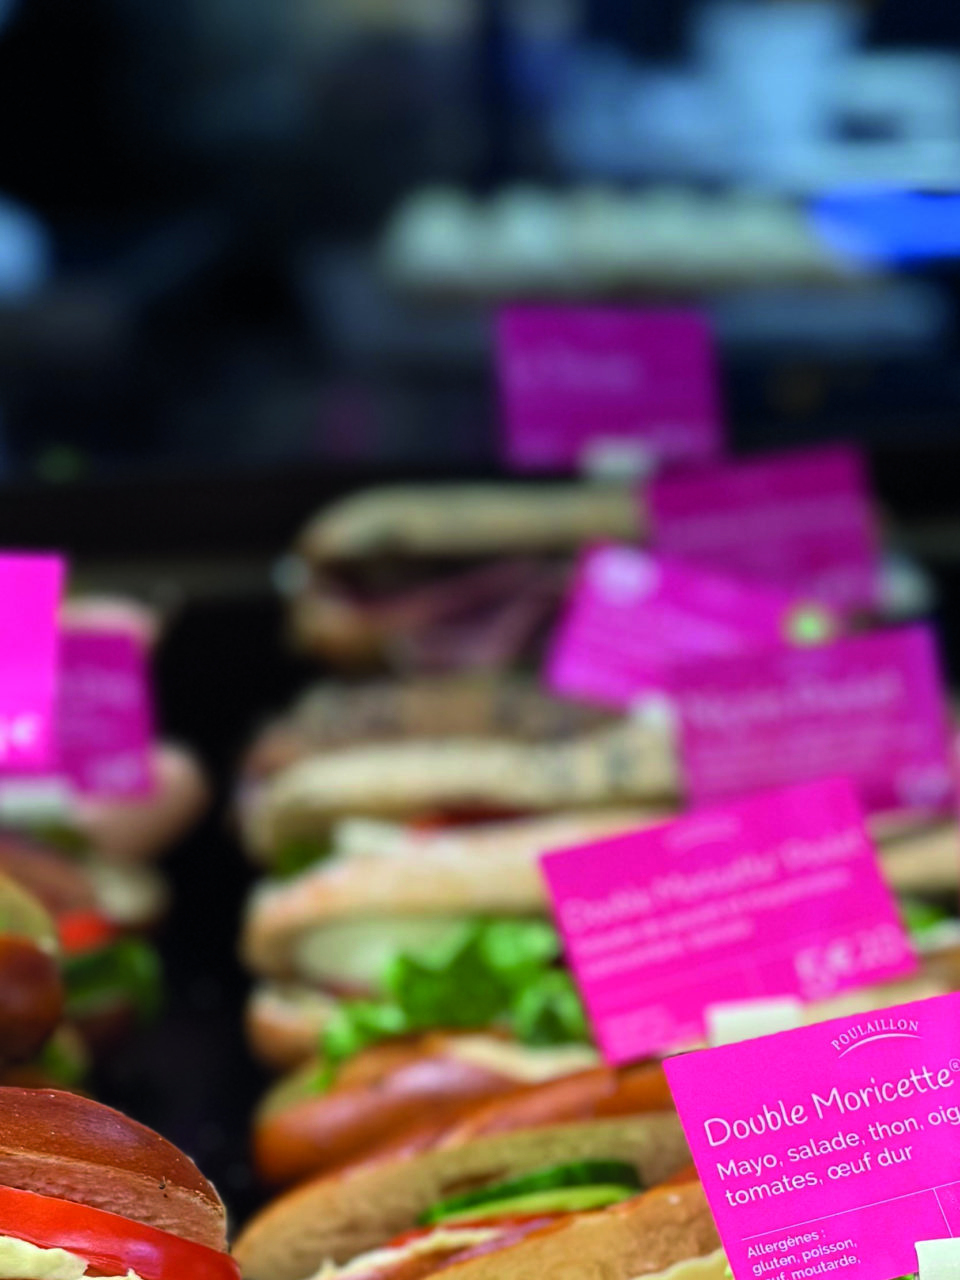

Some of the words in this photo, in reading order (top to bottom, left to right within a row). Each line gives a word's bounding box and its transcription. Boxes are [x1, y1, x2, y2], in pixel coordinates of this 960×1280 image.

[830, 1018, 919, 1051] POULAILLON
[704, 1100, 808, 1147] Double
[716, 1153, 784, 1181] Mayo,
[787, 1131, 866, 1162] salade,
[867, 1117, 924, 1142] thon,
[725, 1171, 823, 1207] tomates,
[827, 1151, 872, 1180] œuf
[877, 1146, 913, 1168] dur
[752, 1254, 800, 1277] gluten,
[802, 1238, 858, 1263] poisson,
[791, 1254, 861, 1280] moutarde,
